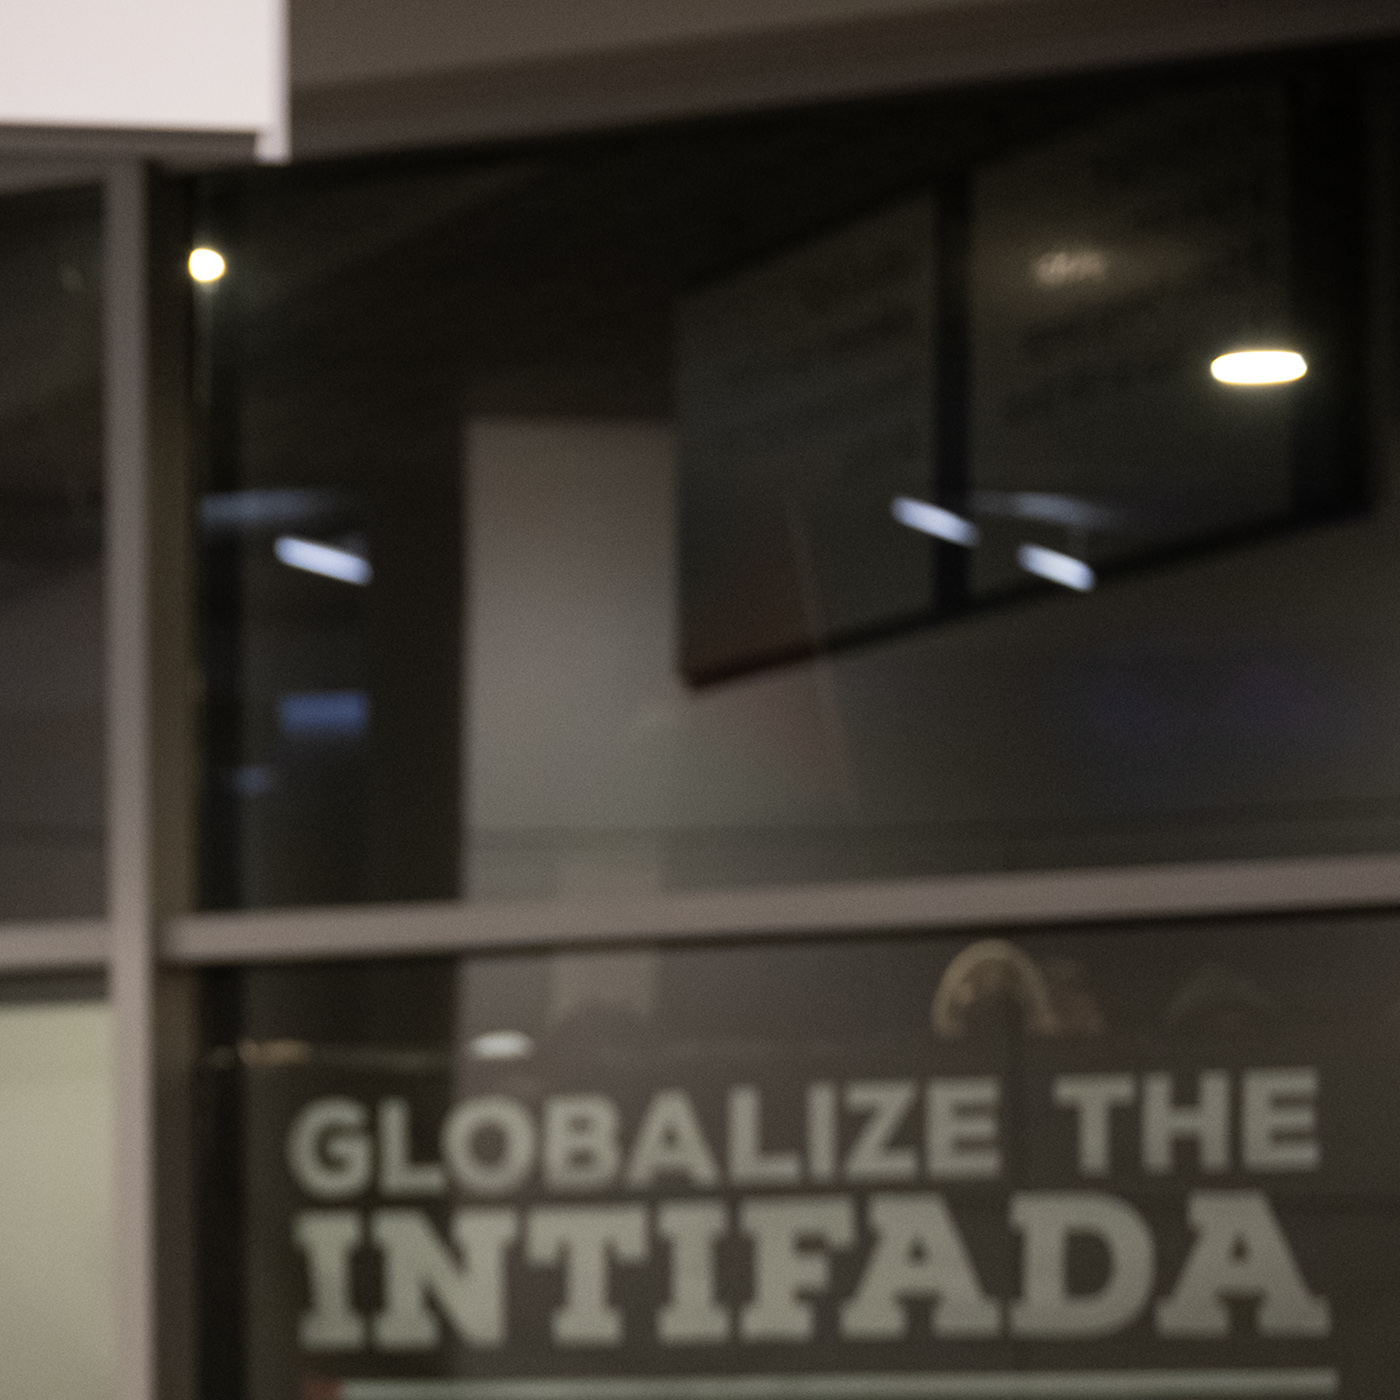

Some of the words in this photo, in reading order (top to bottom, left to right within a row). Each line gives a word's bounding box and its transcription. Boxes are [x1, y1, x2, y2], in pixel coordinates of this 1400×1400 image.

[287, 1077, 1002, 1198] GLOBALIZE
[1053, 1067, 1321, 1177] THE
[292, 1190, 1334, 1350] INTIFADA
